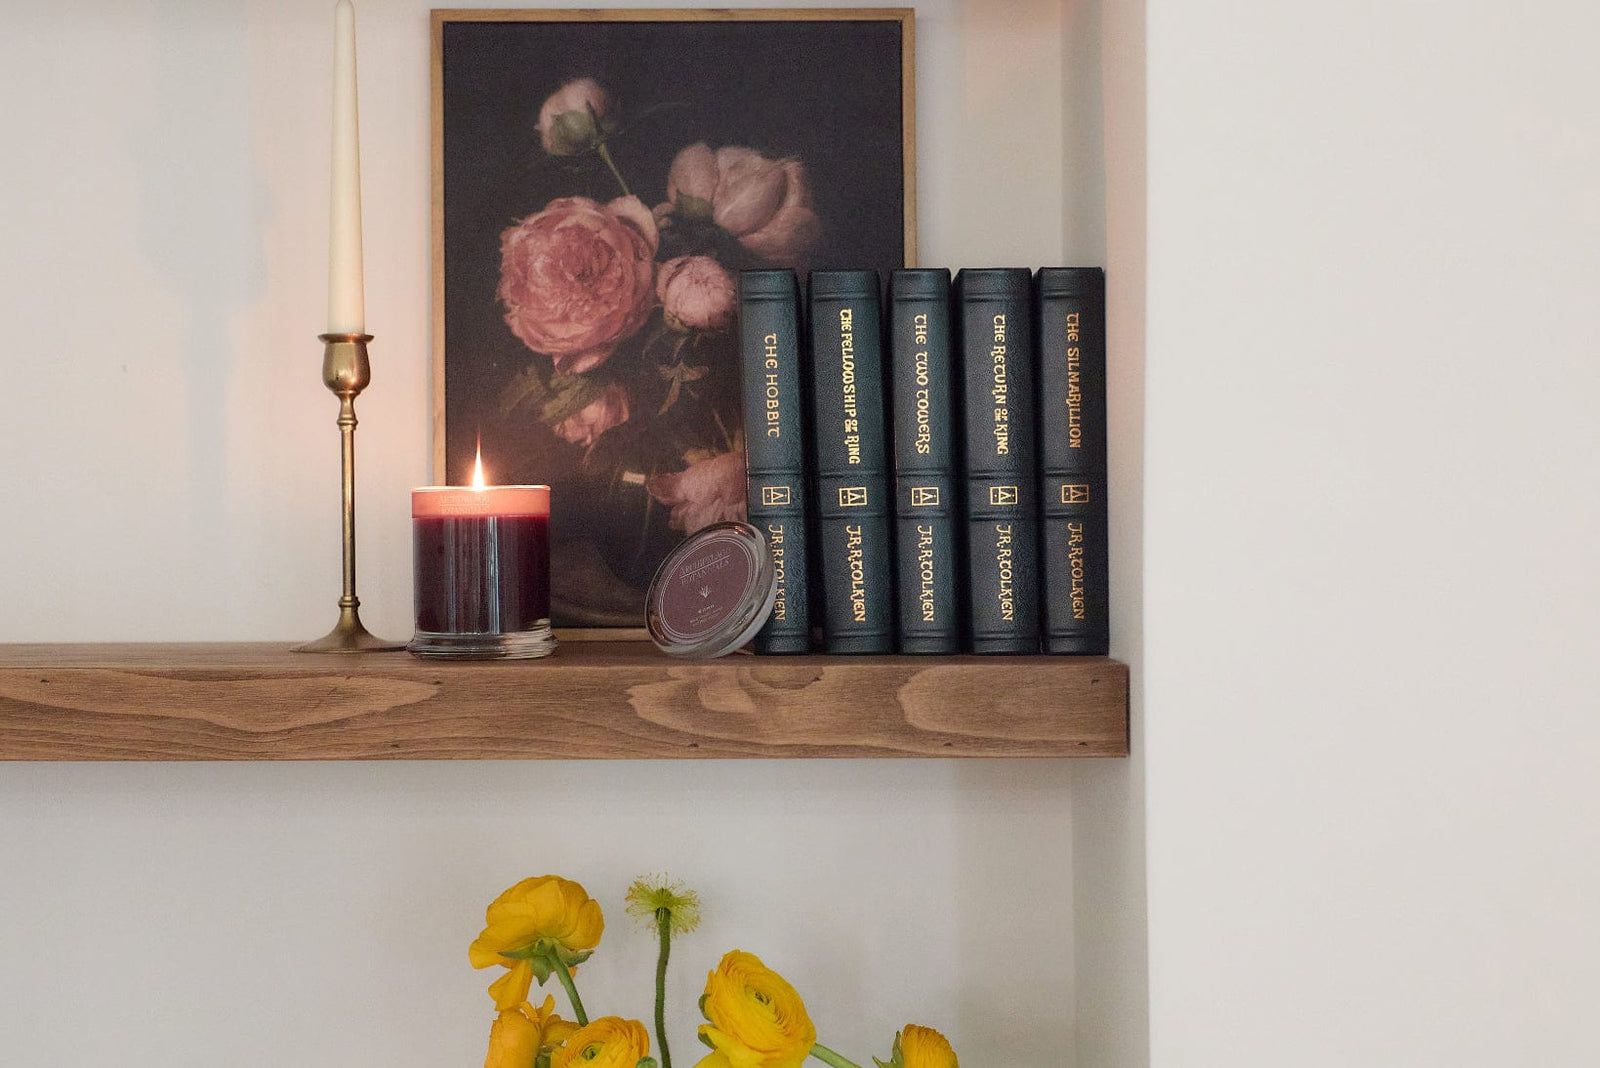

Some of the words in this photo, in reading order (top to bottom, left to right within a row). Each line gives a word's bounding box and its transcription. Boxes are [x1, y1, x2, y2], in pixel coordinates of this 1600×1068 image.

[839, 308, 853, 332] THE
[914, 314, 928, 345] THE
[993, 313, 1006, 342] THE
[1066, 312, 1080, 343] THE
[764, 332, 779, 369] THE
[840, 332, 857, 418] FELLOWSHIP
[915, 351, 929, 387] TWO
[989, 345, 1008, 405] RETURN
[765, 374, 780, 438] HOBBIT
[1065, 347, 1082, 448] SILMARILLION
[915, 389, 931, 454] TOWERS
[993, 423, 1009, 455] KING
[843, 434, 861, 465] RING
